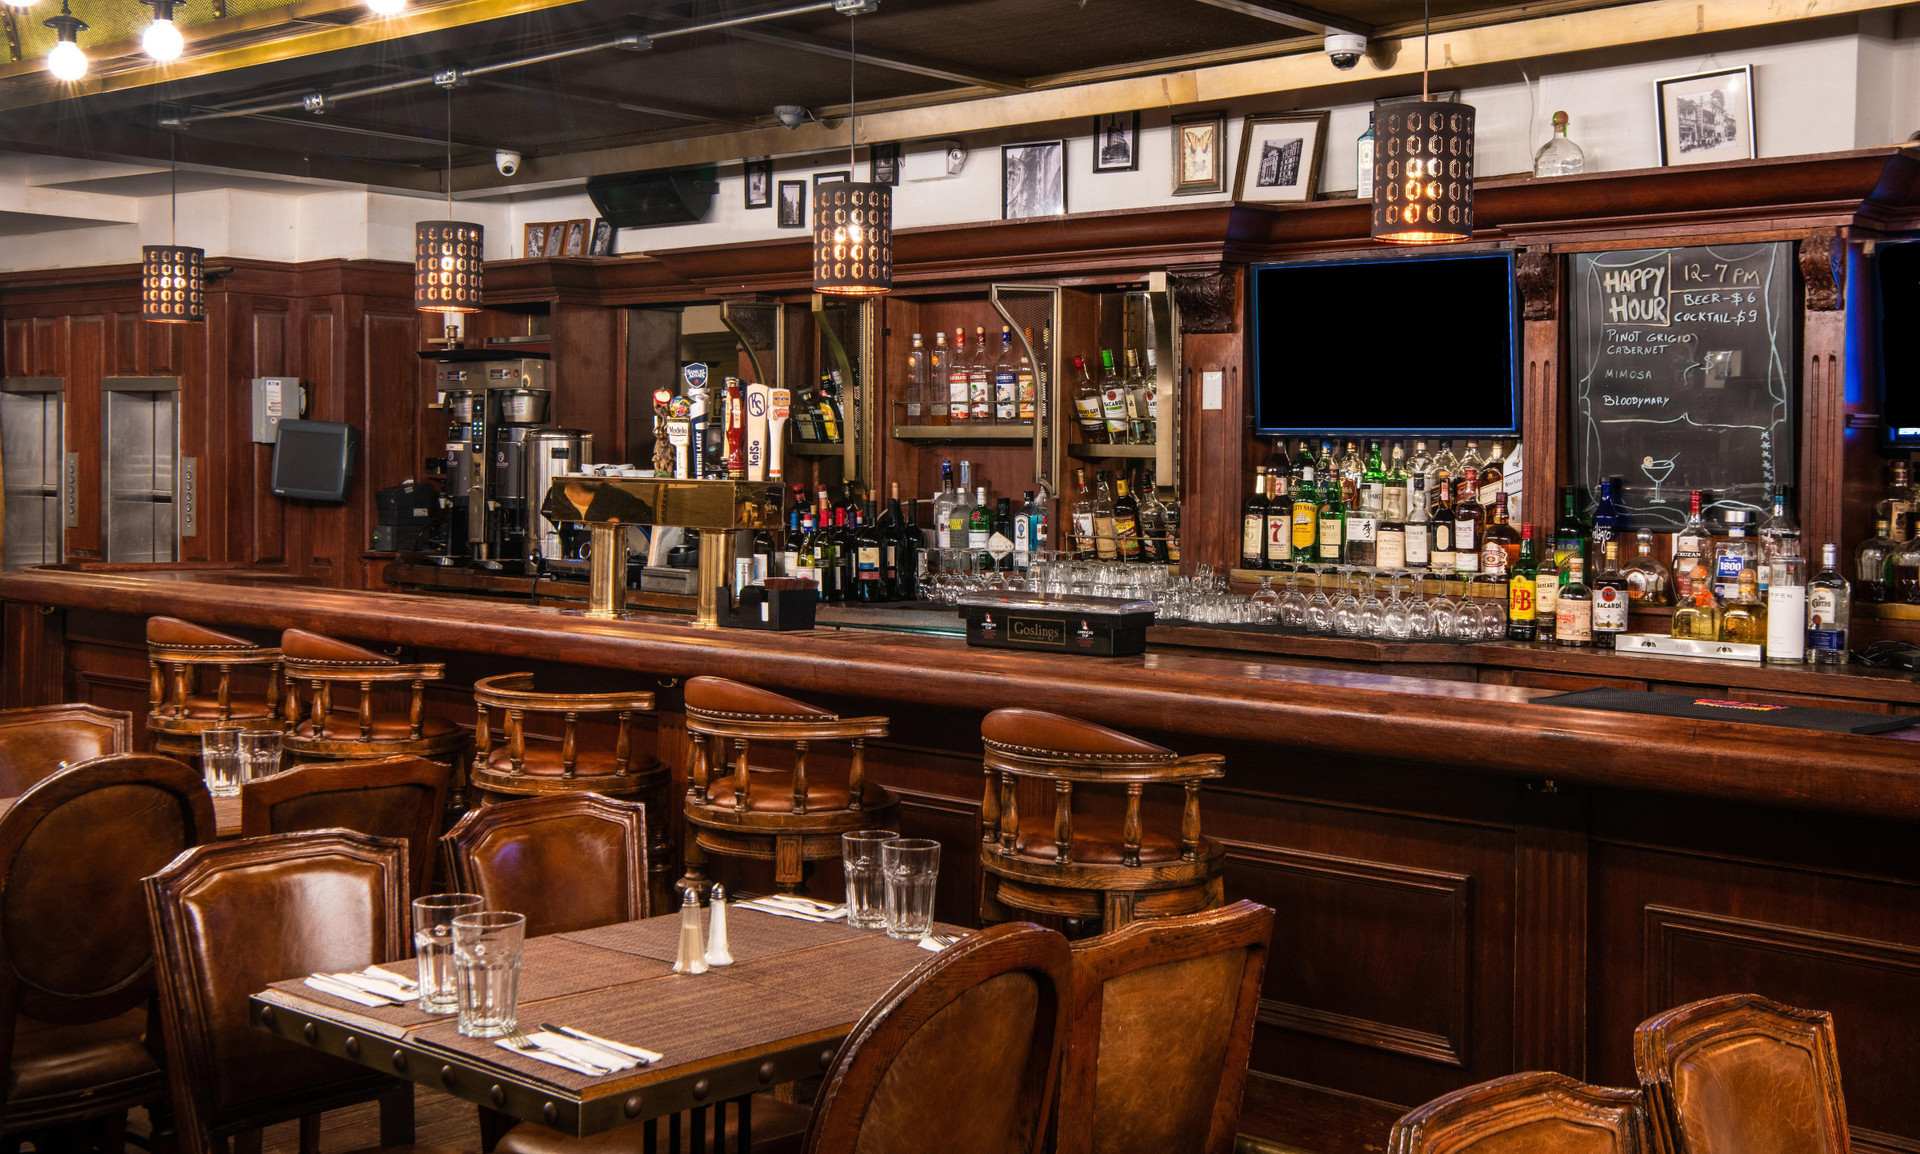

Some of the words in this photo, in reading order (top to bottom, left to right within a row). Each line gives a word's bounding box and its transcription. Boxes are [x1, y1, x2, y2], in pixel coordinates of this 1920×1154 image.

[1604, 266, 1665, 297] HAPPY
[1732, 268, 1761, 286] PM
[1609, 295, 1668, 324] HOUR
[1606, 328, 1642, 343] PINOT
[1646, 333, 1691, 343] GRIGIO
[1606, 344, 1670, 355] CABERNET
[1604, 368, 1652, 379] MIMOSA
[668, 424, 688, 434] Modelo
[749, 440, 760, 467] KelSo
[1720, 561, 1742, 571] 1800
[1510, 588, 1532, 611] J&B
[1597, 601, 1622, 609] BACARDÍ
[1014, 621, 1060, 642] Goslings
